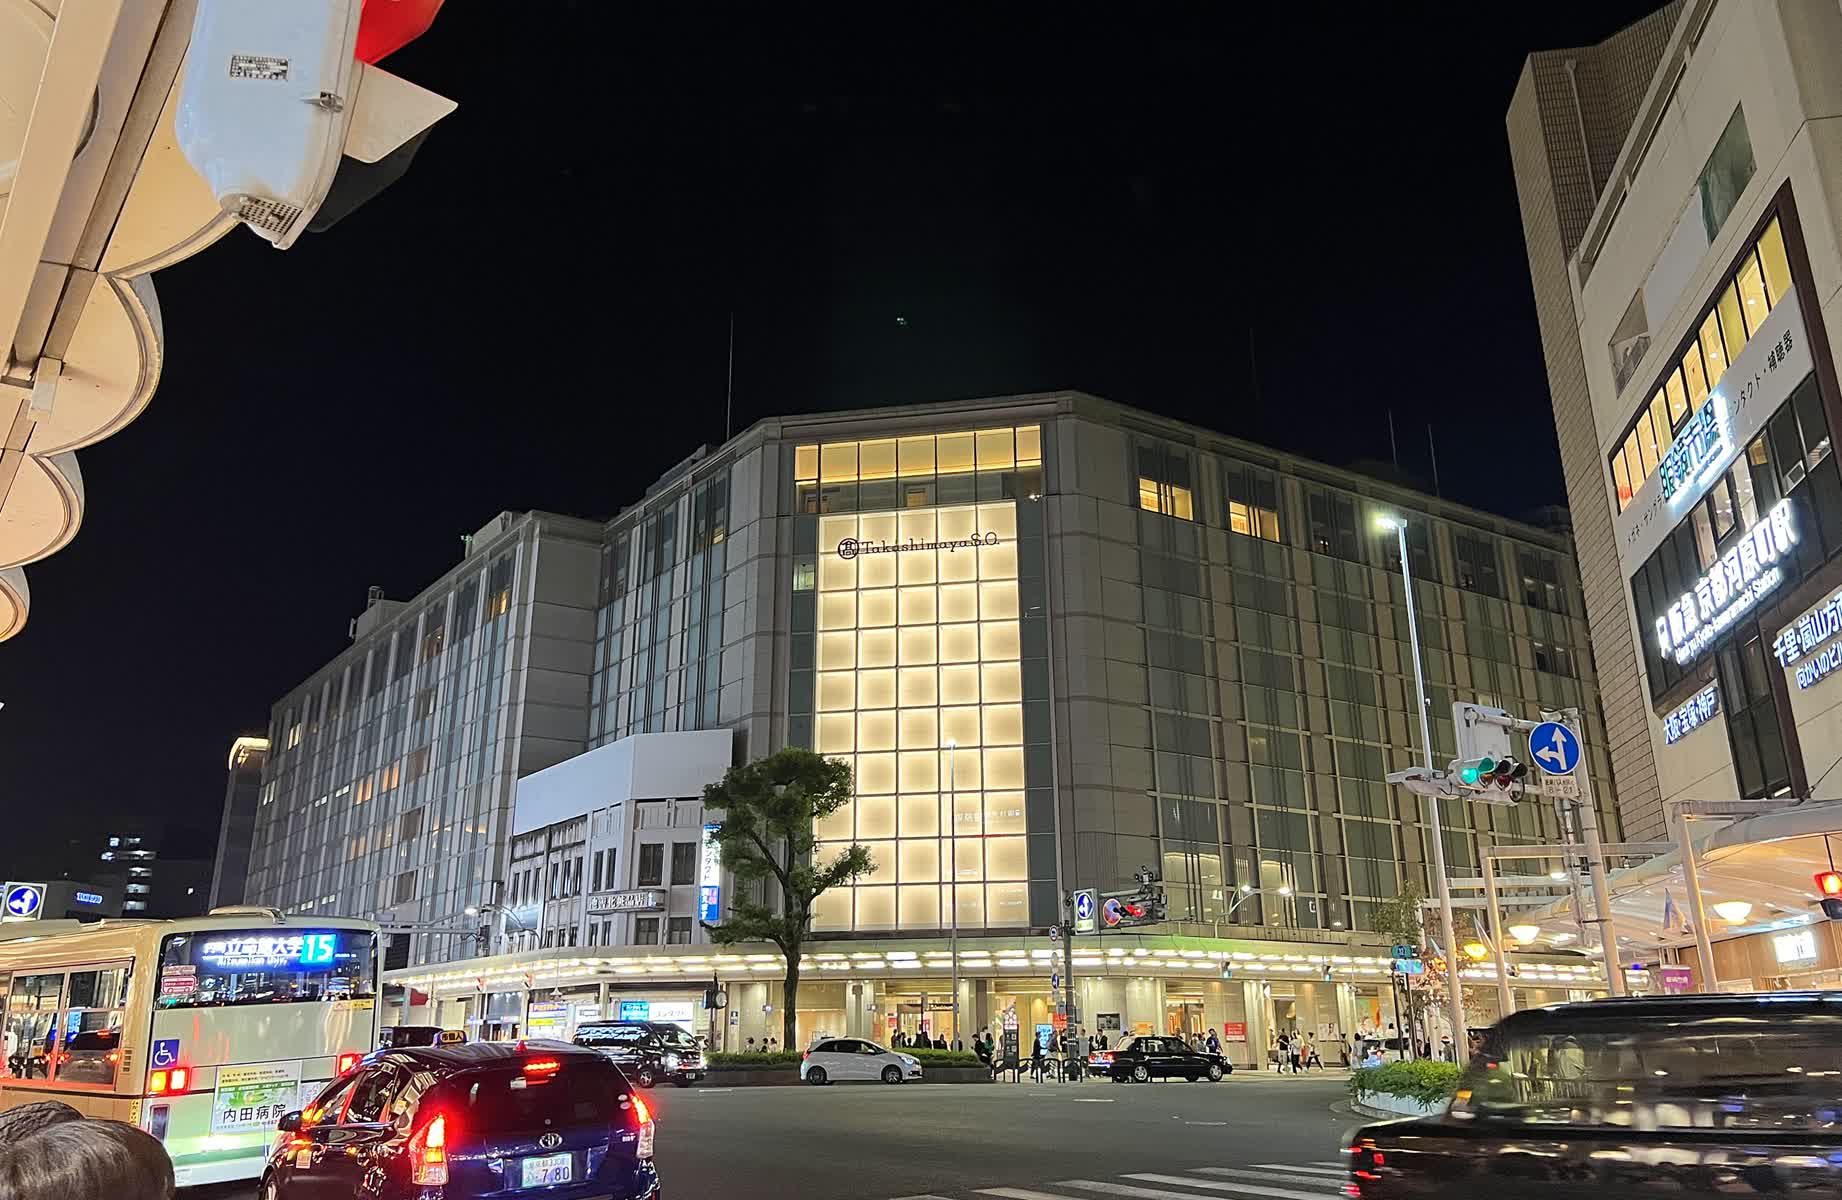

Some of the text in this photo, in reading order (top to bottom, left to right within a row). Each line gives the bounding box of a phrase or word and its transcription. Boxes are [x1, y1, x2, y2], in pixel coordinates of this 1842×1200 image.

[860, 537, 967, 555] Takashimaya
[1663, 686, 1718, 745] 大阪・宝塚・神戸
[306, 935, 332, 961] 15
[223, 1103, 287, 1123] 内田病院
